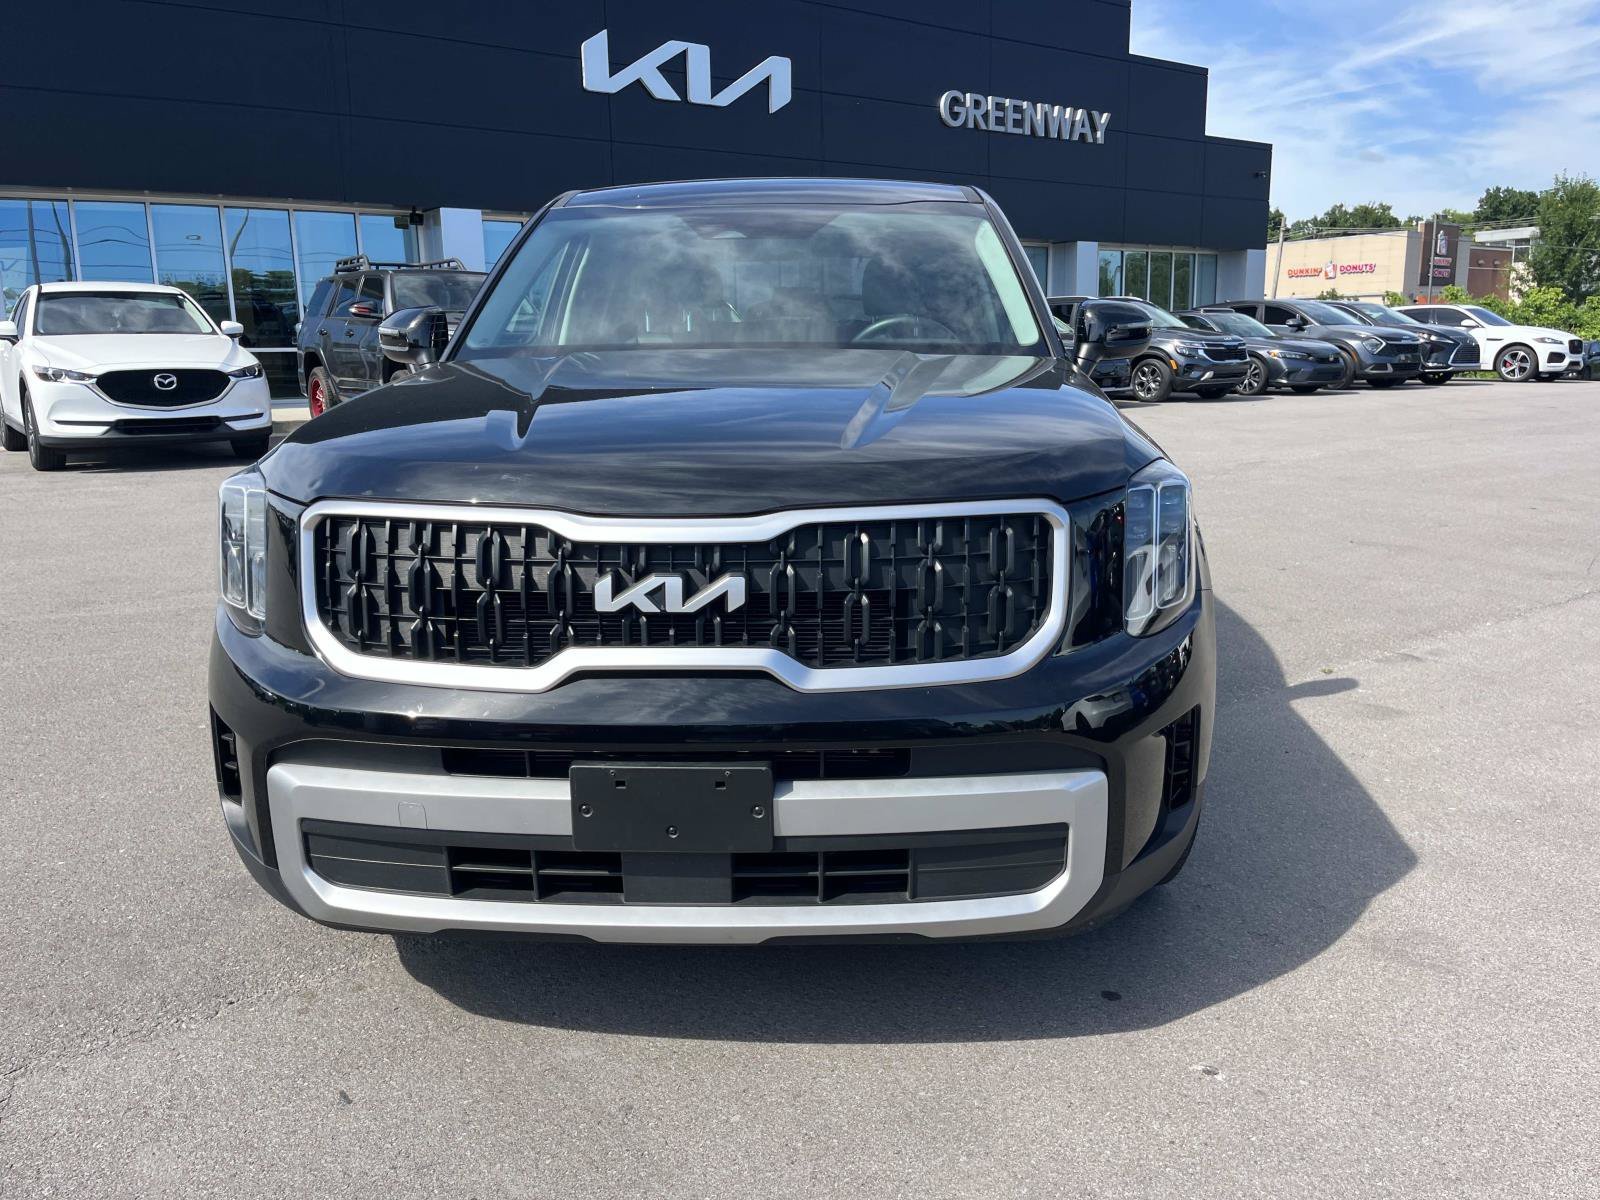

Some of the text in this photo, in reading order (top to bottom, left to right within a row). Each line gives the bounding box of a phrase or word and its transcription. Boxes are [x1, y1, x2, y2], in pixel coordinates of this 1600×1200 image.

[581, 28, 792, 114] KIA
[940, 89, 1111, 145] GREENWAY
[594, 573, 746, 613] KIA
